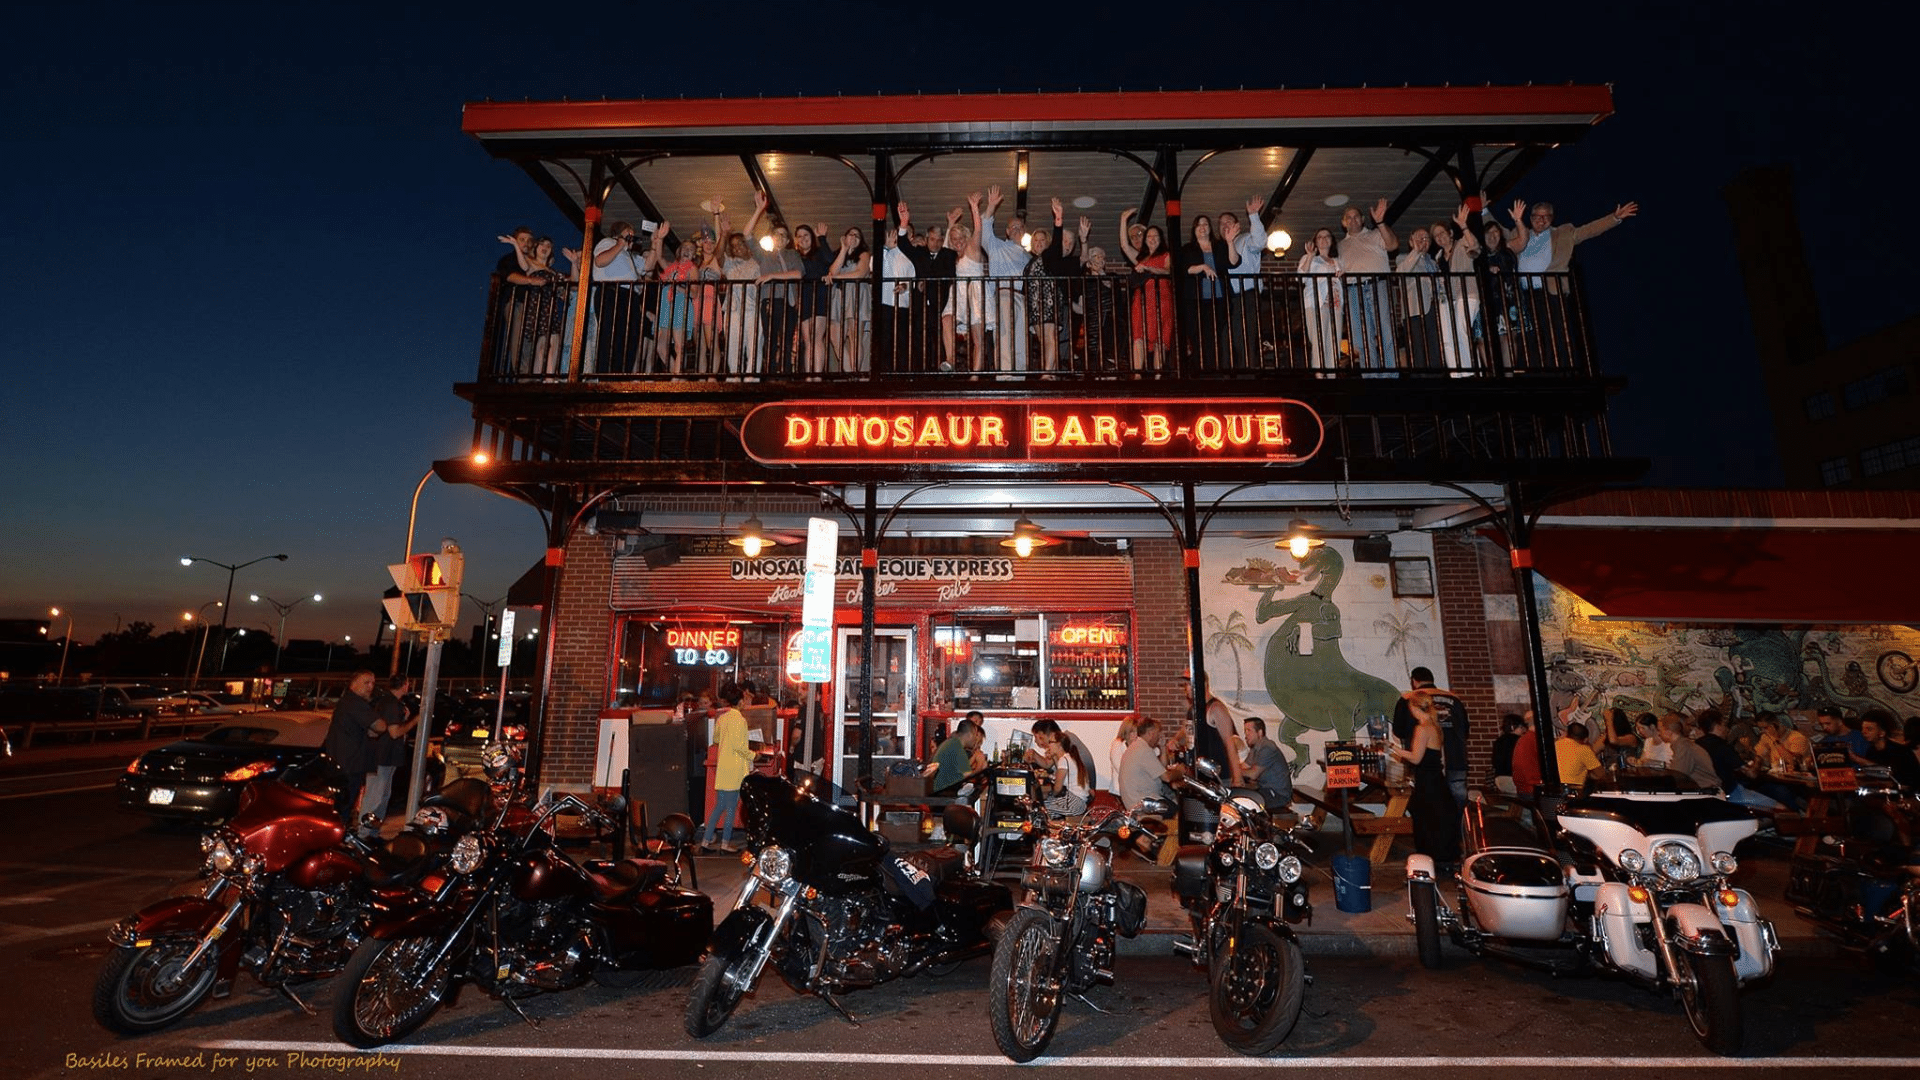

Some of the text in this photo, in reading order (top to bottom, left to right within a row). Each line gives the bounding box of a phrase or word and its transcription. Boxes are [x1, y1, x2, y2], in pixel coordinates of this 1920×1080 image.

[784, 412, 1291, 449] DINOSAUR BAR-B-QUE
[732, 559, 1010, 577] DINOSAU BAREQUE EXPRESS
[937, 578, 972, 602] Ribs
[667, 630, 738, 647] DINNER
[1061, 627, 1113, 645] OPEN
[674, 648, 729, 665] TO GO
